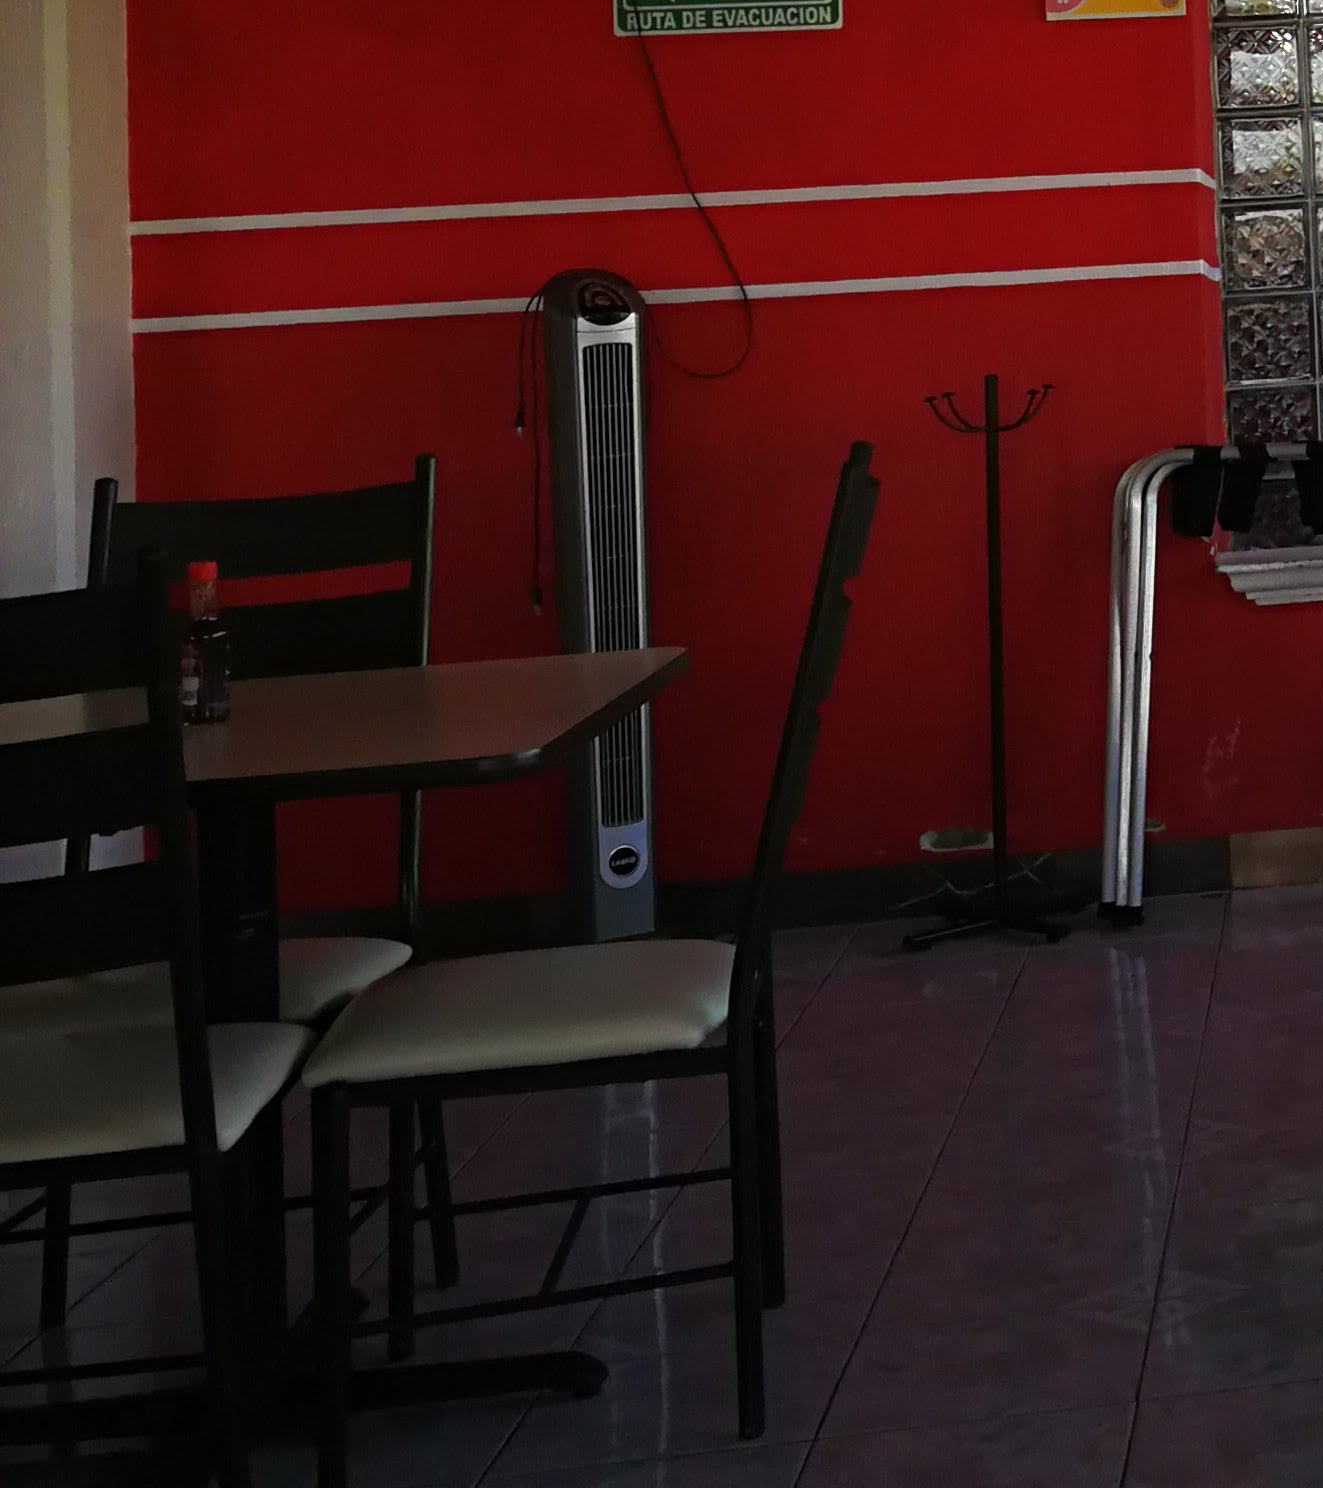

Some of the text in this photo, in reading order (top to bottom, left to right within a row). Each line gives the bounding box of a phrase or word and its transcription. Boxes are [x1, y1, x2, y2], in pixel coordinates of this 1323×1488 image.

[627, 6, 832, 30] RUTA DE EVACUACION
